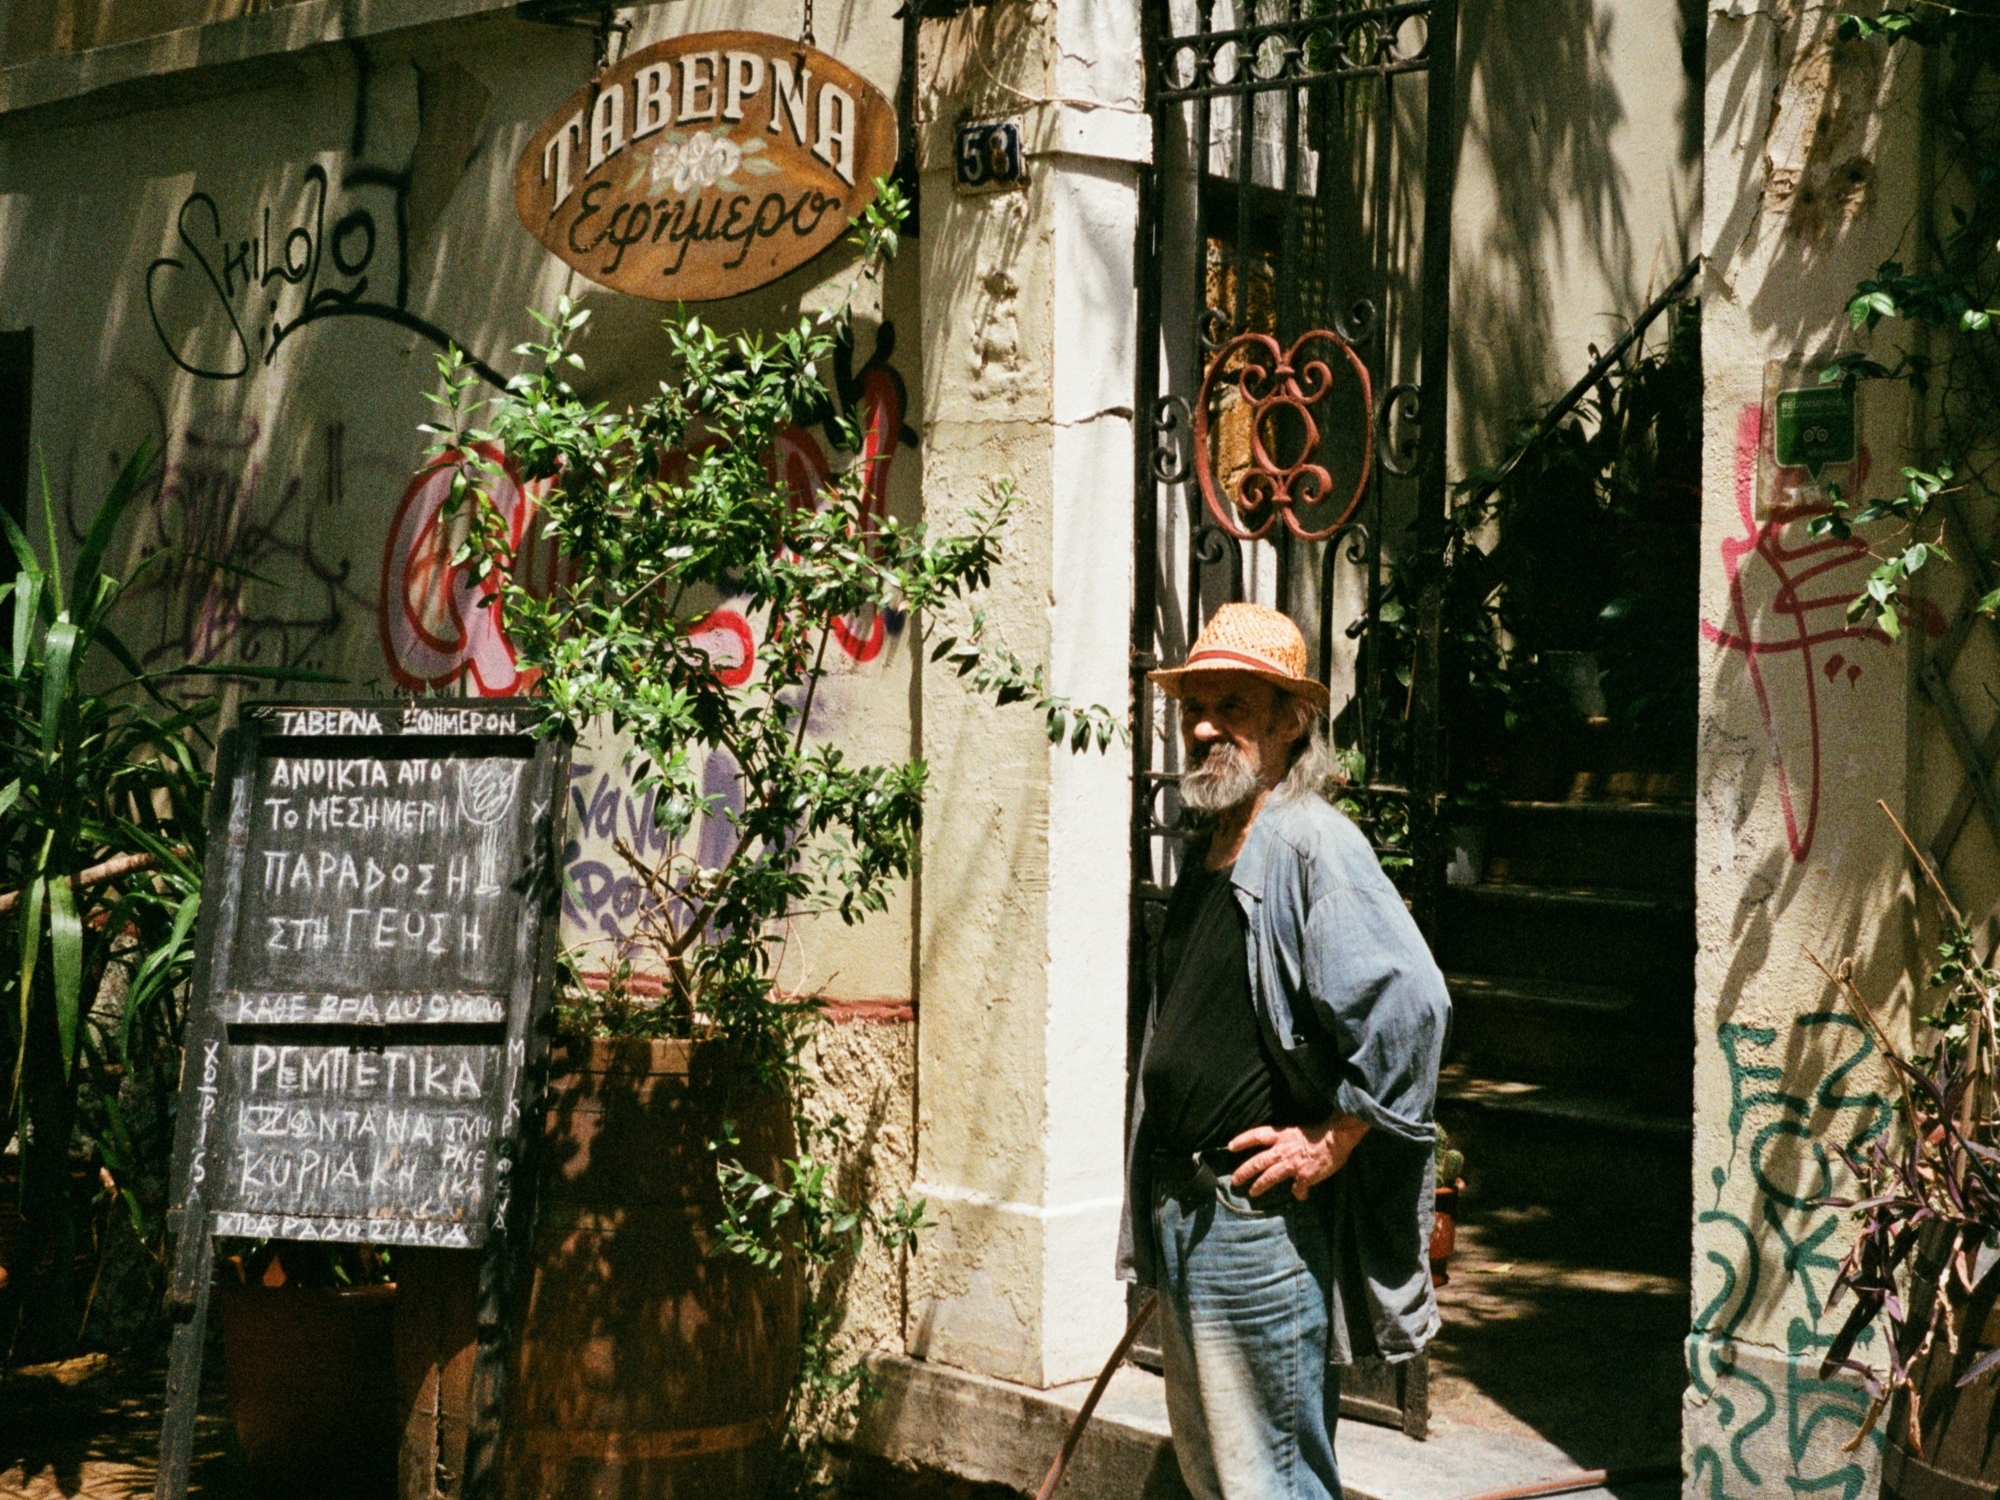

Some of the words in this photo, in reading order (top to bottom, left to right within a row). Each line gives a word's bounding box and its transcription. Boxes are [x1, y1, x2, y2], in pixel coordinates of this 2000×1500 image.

[544, 50, 857, 212] ΤΑΒΕΡΝΑ
[280, 710, 383, 736] ΤΑΒΕΡΝΑ
[271, 758, 389, 791] ΑΝΟΙΚΤΑ
[250, 1045, 482, 1098] ΡΕΜΠΕΤΙΚΑ
[240, 1148, 419, 1196] ΚΥΡΙΑΚΗ
